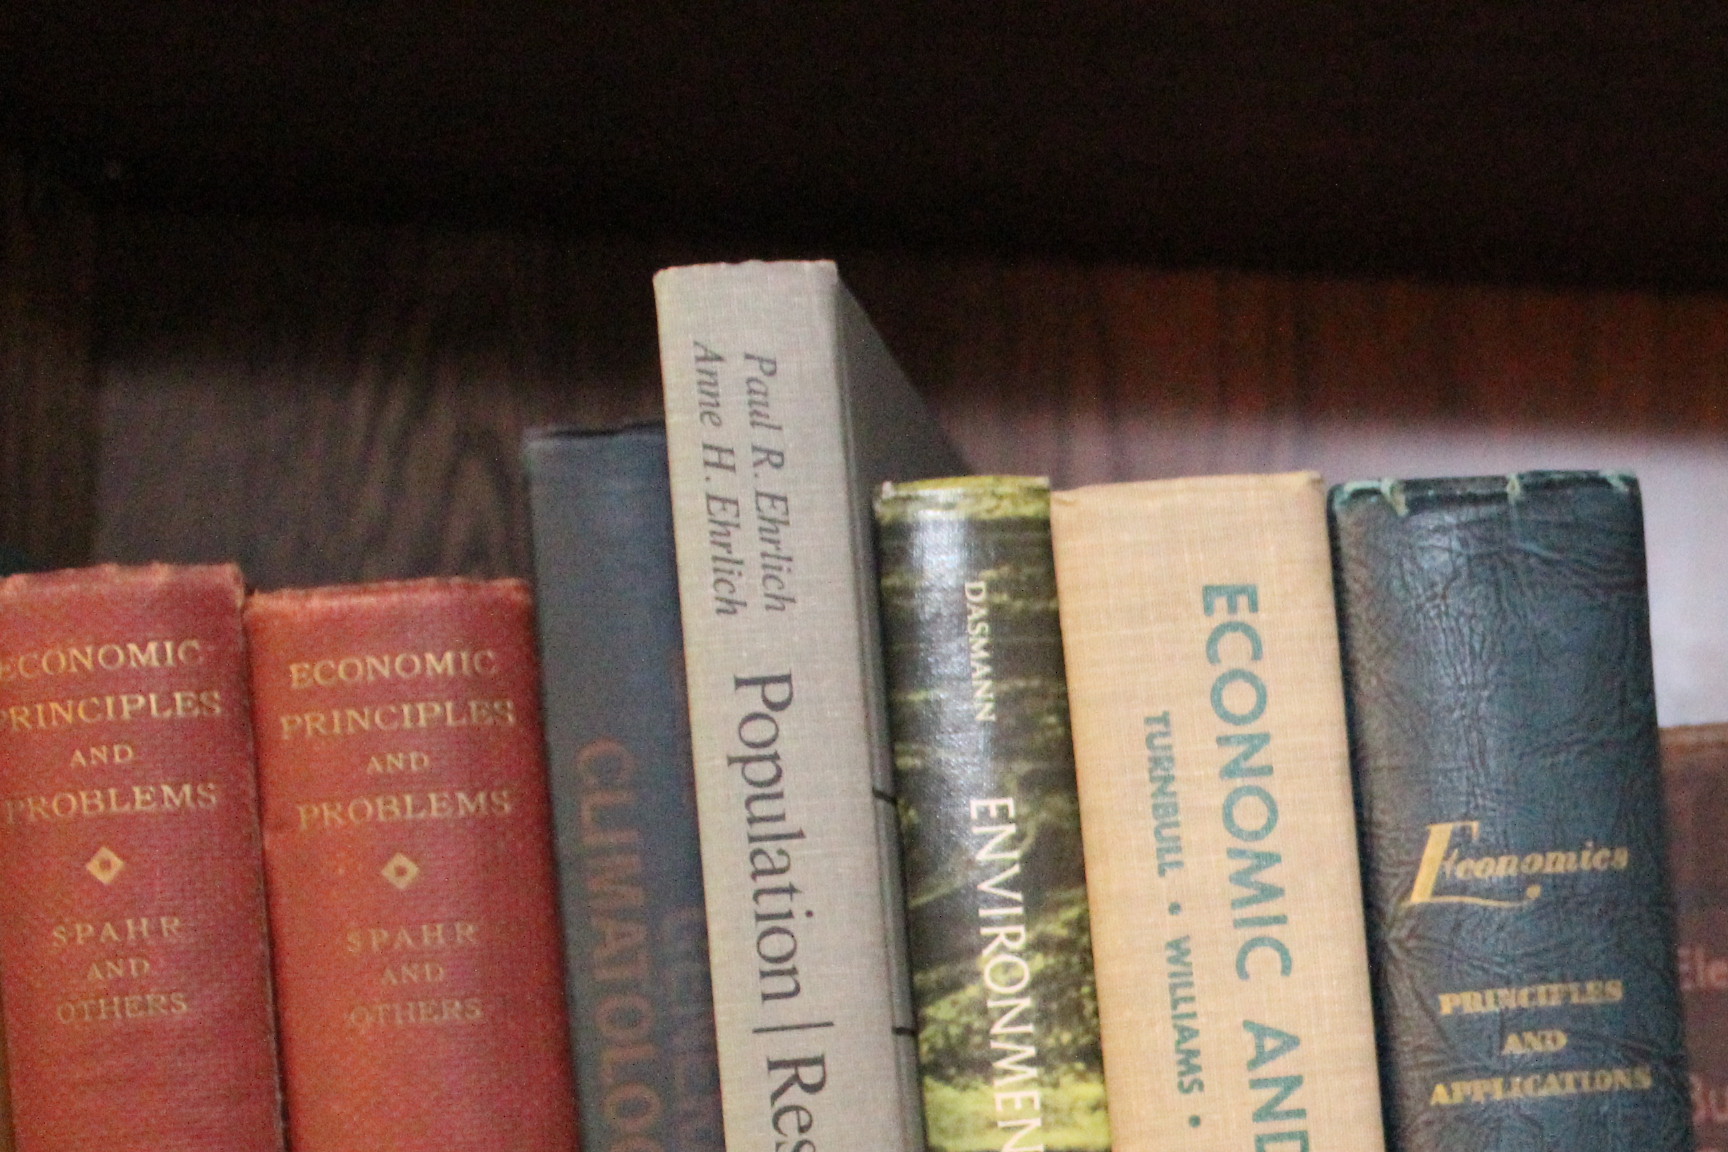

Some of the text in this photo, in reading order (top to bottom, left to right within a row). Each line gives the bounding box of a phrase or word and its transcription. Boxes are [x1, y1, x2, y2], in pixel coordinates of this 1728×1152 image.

[693, 340, 747, 617] Anne H. Ehrlich
[743, 353, 796, 613] Paul R. Ehrlich
[0, 639, 201, 681] ECONOMIC
[289, 649, 498, 688] ECONOMIC
[964, 581, 996, 722] DASMANN
[279, 700, 516, 740] PRINCIPLES
[71, 743, 134, 768] AND
[365, 751, 430, 774] AND
[1201, 583, 1292, 981] ECONOMIC
[4, 783, 218, 825] PROBLEMS
[298, 790, 513, 830] PROBLEMS
[727, 668, 814, 1003] Population
[1401, 820, 1629, 908] Economics
[1143, 711, 1183, 877] TURNBULL
[1165, 934, 1204, 1095] WILLIAMS
[51, 915, 183, 948] SPAHR
[348, 921, 480, 953] SPAHR
[87, 957, 151, 981] AND
[380, 961, 444, 984] AND
[56, 992, 188, 1025] OTHERS
[350, 998, 484, 1028] OTHERS
[1438, 979, 1624, 1016] PRINCIPLES
[1502, 1030, 1568, 1055] AND
[1430, 1065, 1652, 1106] APPLICATIONS
